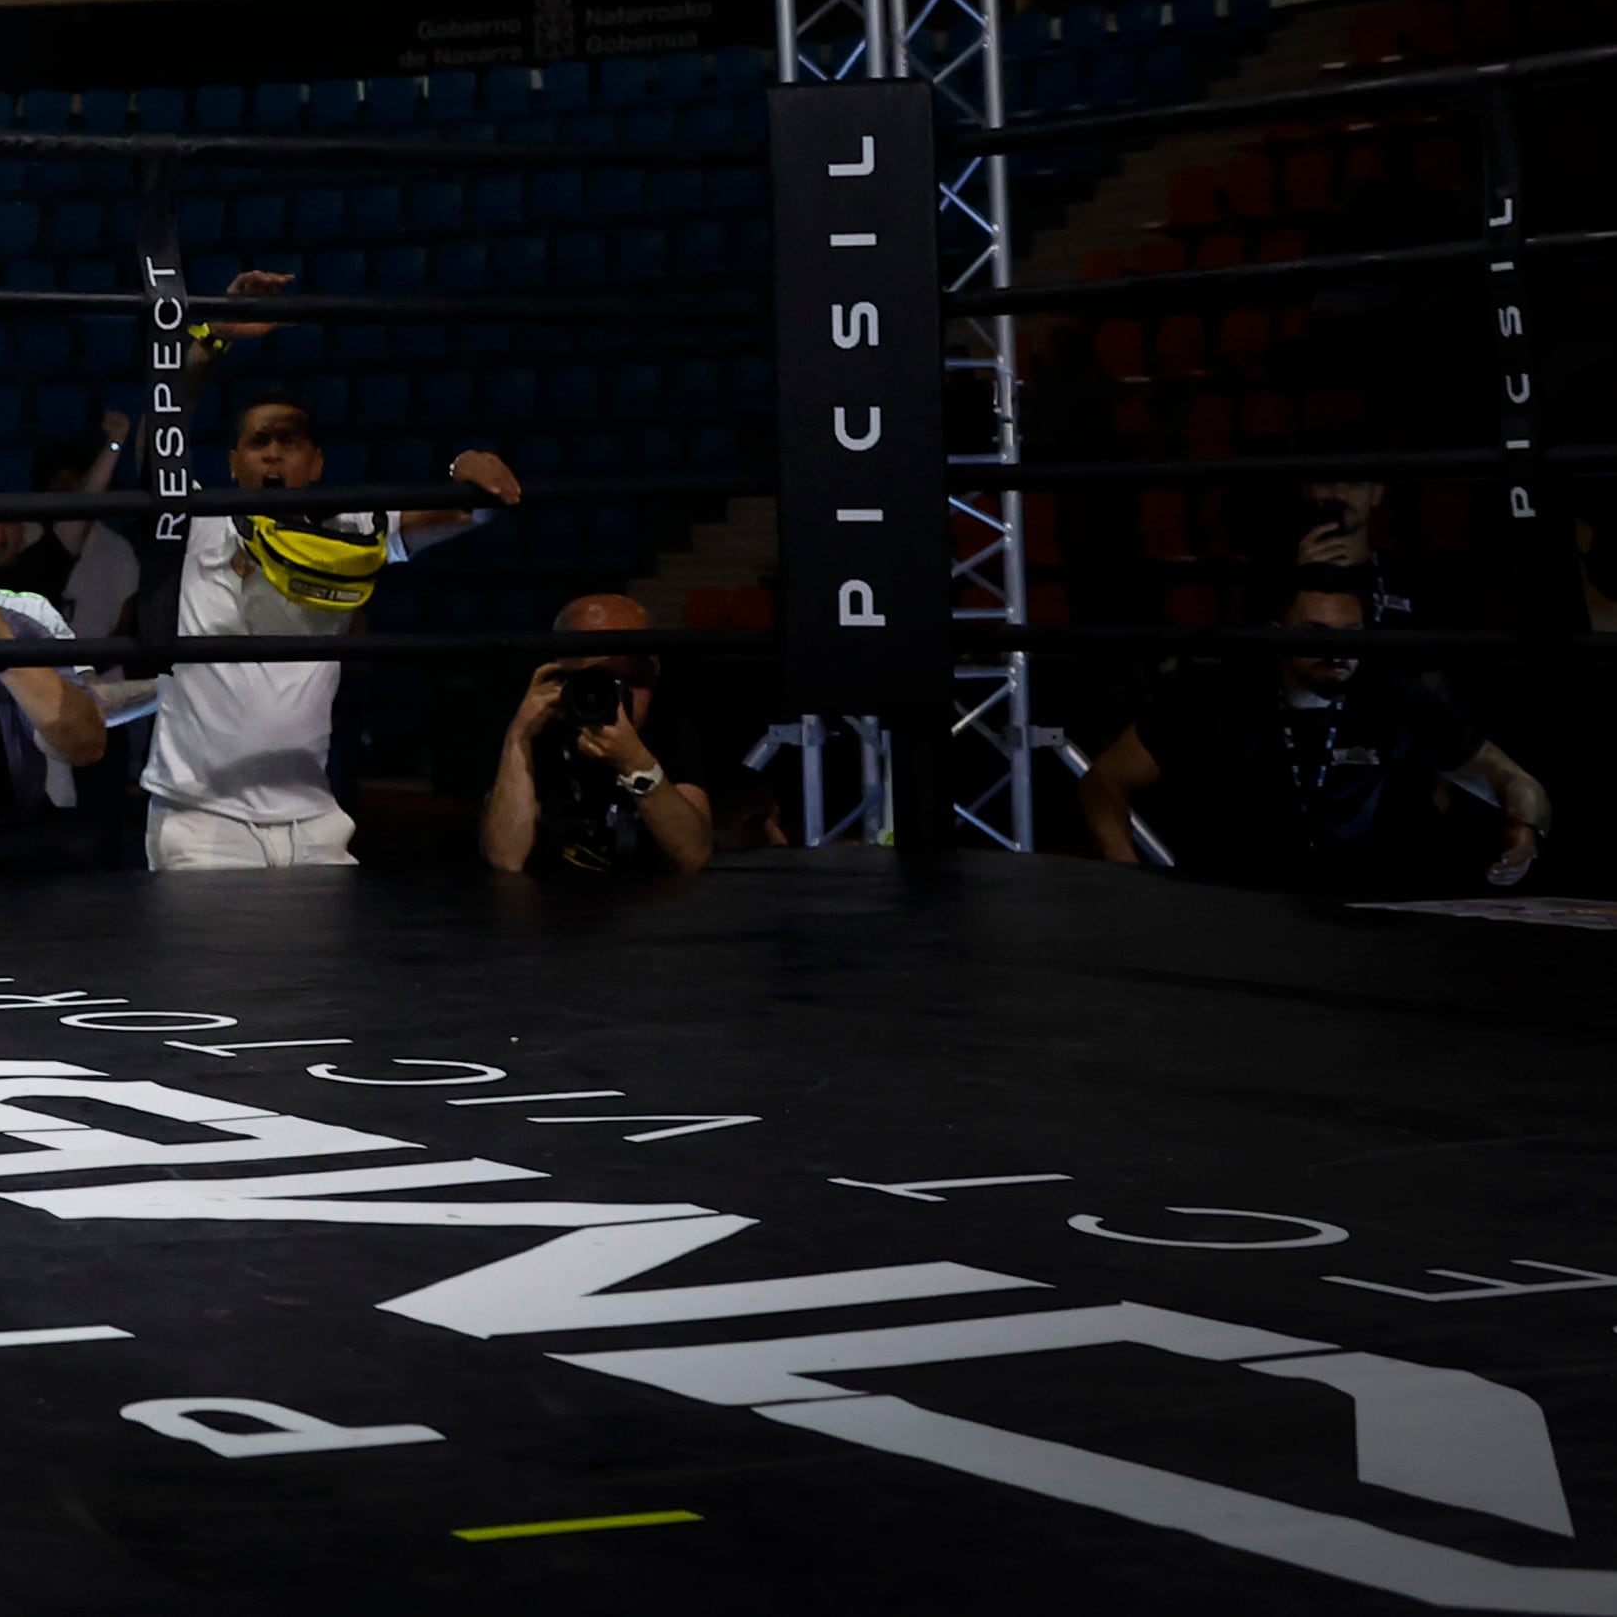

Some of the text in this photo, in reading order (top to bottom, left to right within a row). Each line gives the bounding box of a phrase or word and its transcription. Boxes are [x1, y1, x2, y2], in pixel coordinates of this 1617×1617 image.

[145, 255, 189, 540] RESPECT
[827, 134, 888, 628] PICSIL
[1487, 196, 1538, 519] PICSIL
